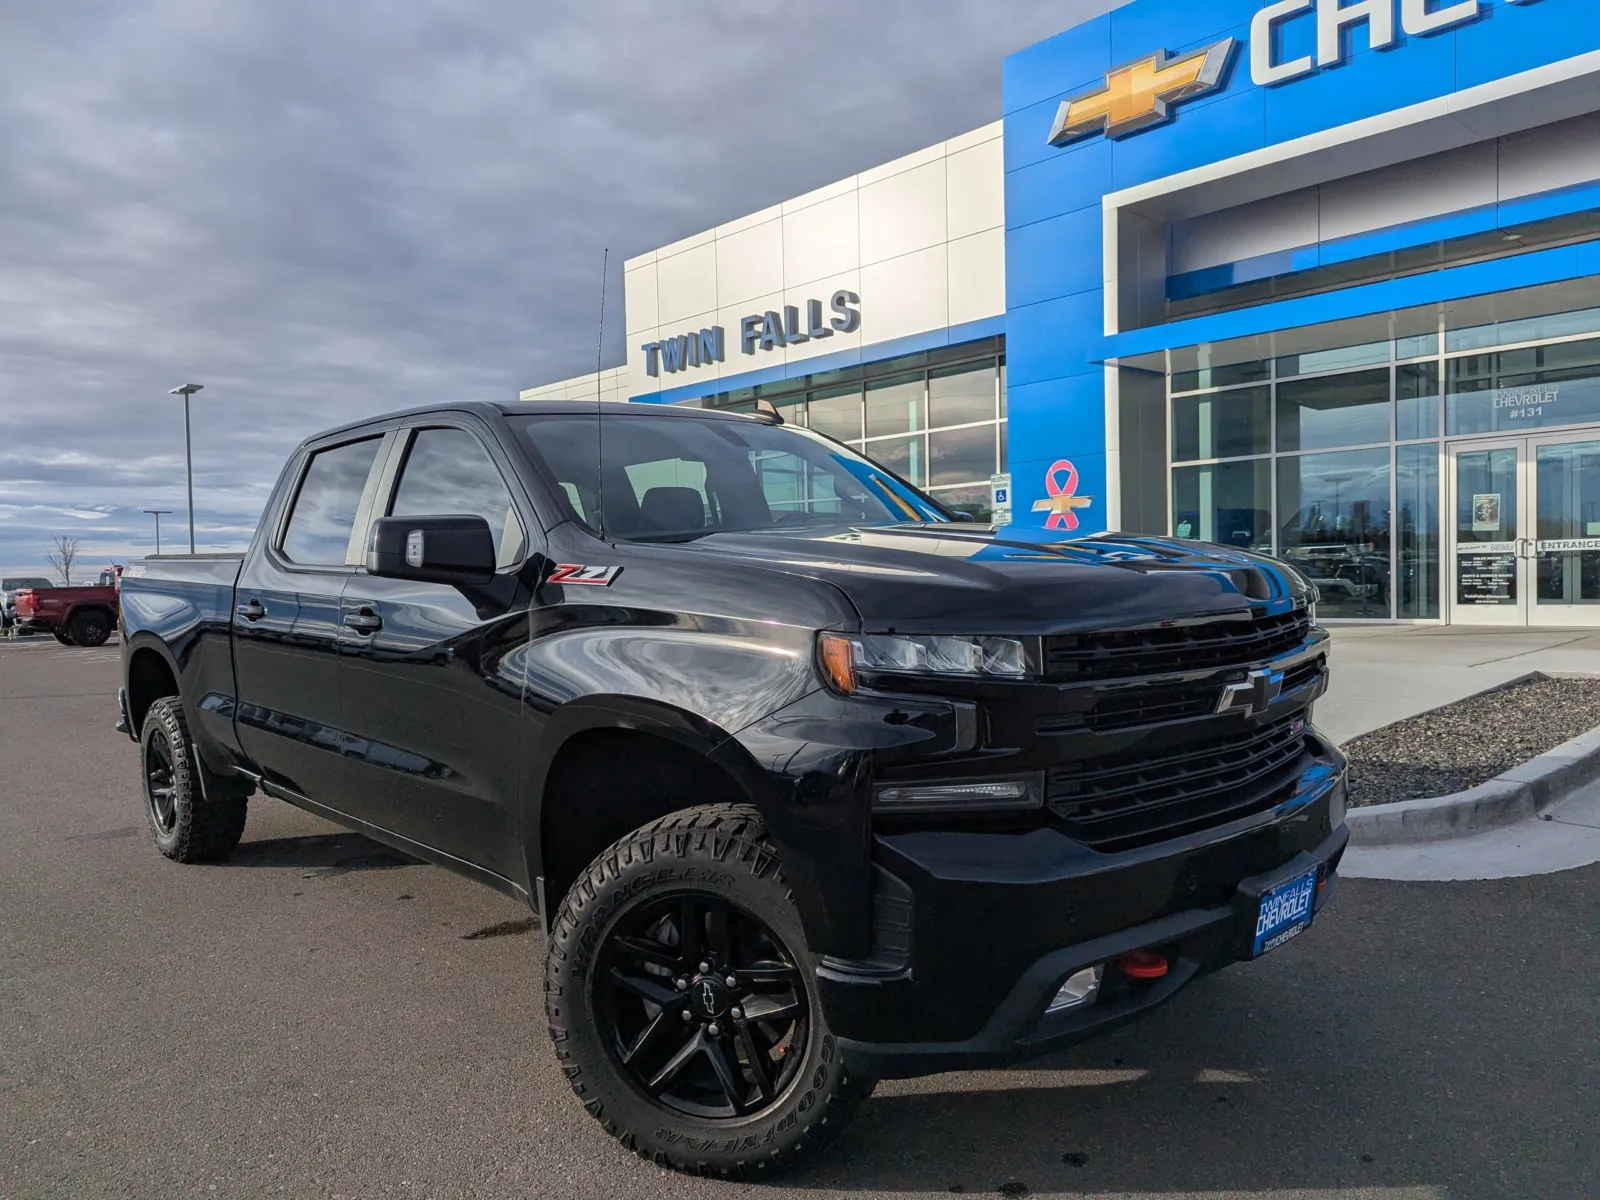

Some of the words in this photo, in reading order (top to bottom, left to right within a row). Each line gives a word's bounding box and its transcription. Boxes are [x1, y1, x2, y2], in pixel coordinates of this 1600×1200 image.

[641, 325, 725, 377] TWIN
[741, 289, 861, 355] FALLS
[1493, 391, 1560, 409] CHEVROLET
[1510, 406, 1543, 419] #131
[1541, 540, 1600, 550] ENTRANCE
[546, 563, 624, 587] Z71
[570, 866, 736, 979] WRANGLER
[1255, 889, 1312, 937] CHEVROLET
[653, 1033, 835, 1153] GOODYEAR
